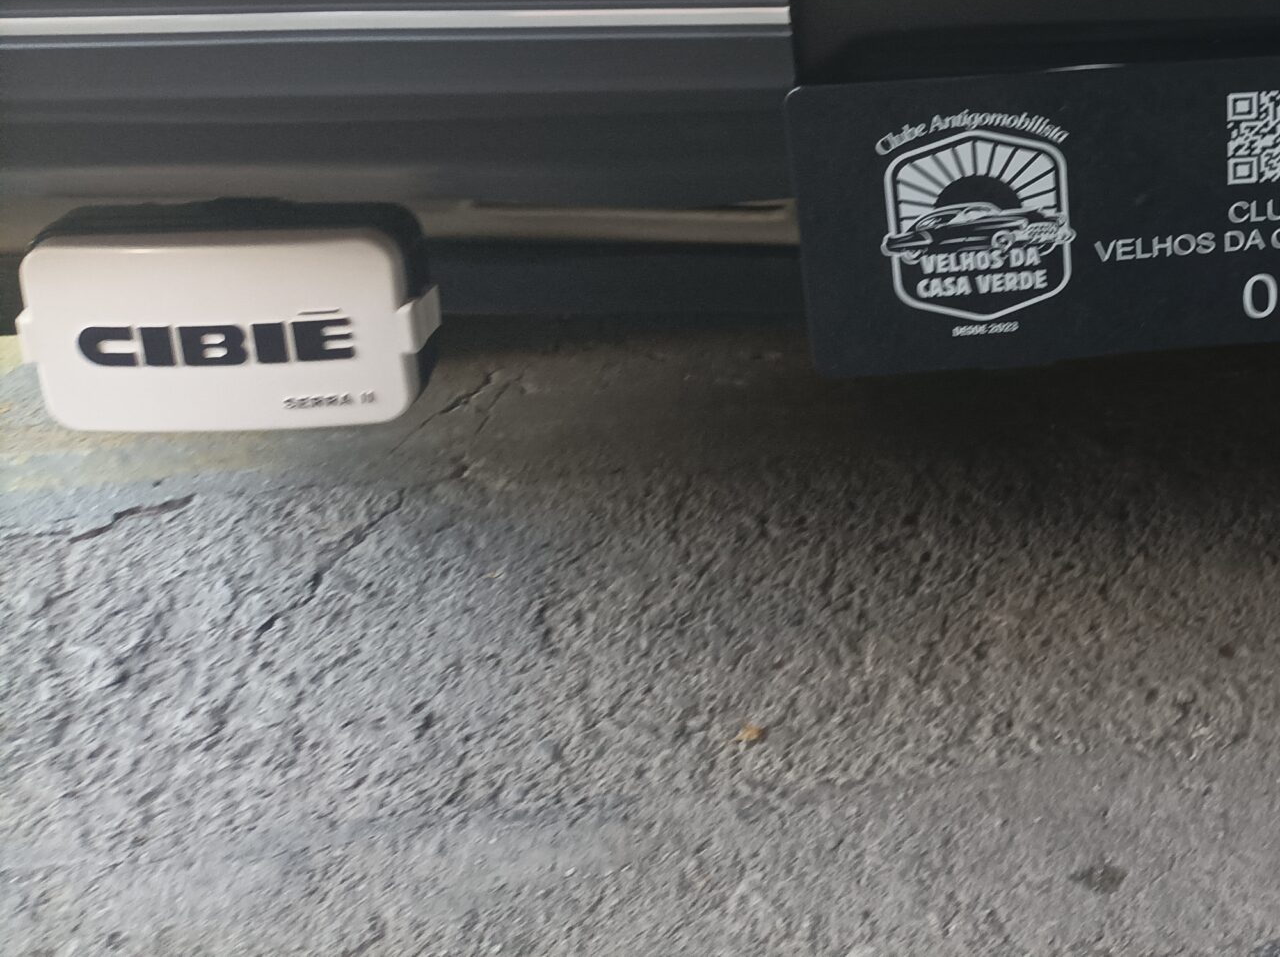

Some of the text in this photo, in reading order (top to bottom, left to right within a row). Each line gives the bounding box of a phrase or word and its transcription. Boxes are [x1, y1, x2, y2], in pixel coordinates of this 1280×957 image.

[1094, 232, 1216, 262] VELHOS
[1223, 230, 1266, 253] DA
[919, 247, 1041, 274] VELHOS DA
[916, 269, 1048, 298] CASA VERDE
[282, 394, 352, 409] SERRA
